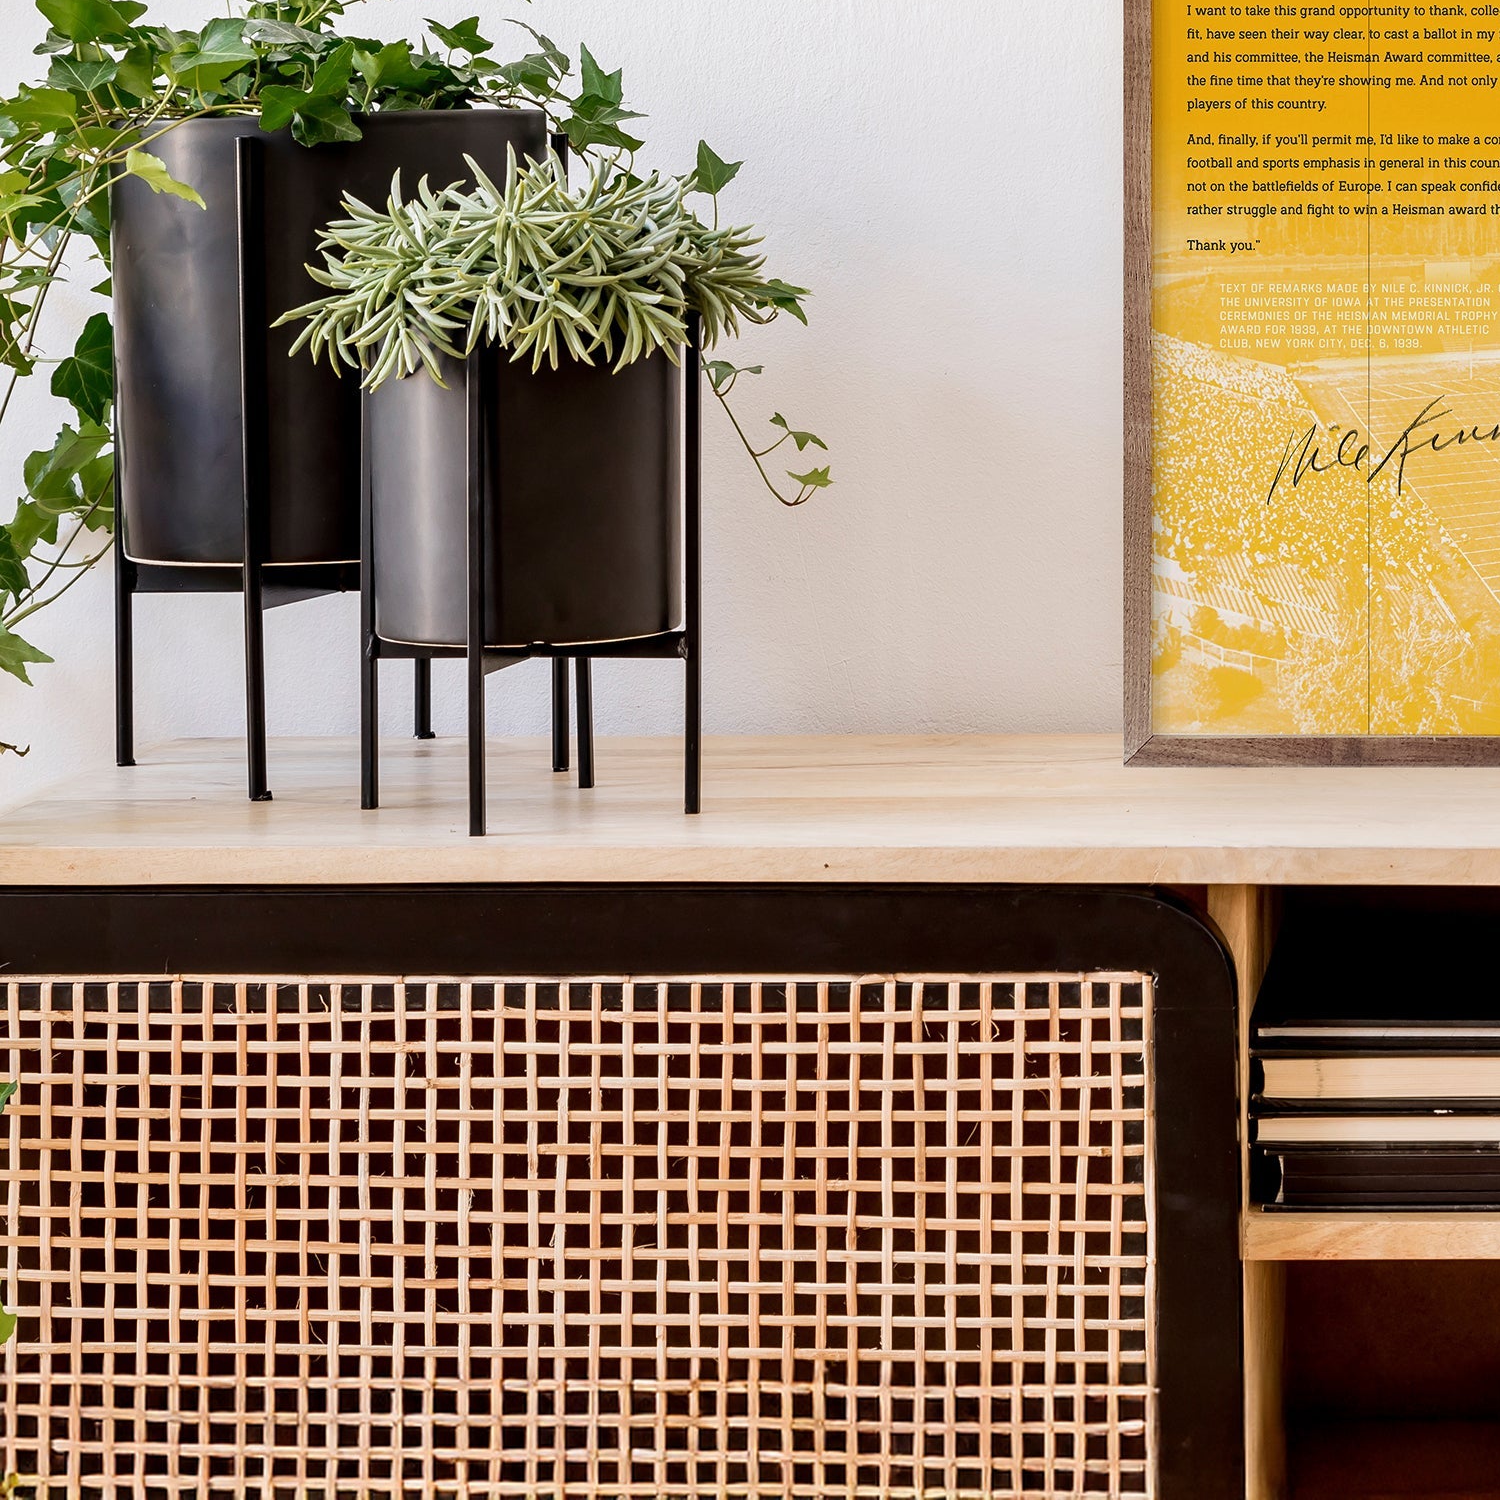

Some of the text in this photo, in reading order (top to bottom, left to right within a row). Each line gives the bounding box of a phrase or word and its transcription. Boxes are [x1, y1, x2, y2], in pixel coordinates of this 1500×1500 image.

[1186, 74, 1207, 87] the
[1209, 74, 1234, 87] fine
[1236, 75, 1264, 87] time
[1266, 74, 1291, 87] that
[1338, 74, 1392, 91] showing
[1395, 77, 1416, 87] me.
[1419, 74, 1445, 86] And
[1447, 75, 1468, 87] not
[1470, 74, 1499, 90] only
[1186, 203, 1224, 216] rather
[1226, 203, 1278, 219] struggle
[1280, 203, 1304, 216] and
[1306, 203, 1335, 219] fight
[1337, 204, 1351, 216] to
[1353, 203, 1378, 216] win
[1381, 206, 1389, 216] a
[1392, 203, 1445, 216] Heisman
[1448, 203, 1487, 216] award
[1186, 239, 1227, 251] Thank
[1219, 283, 1246, 293] TEXT
[1250, 283, 1264, 293] OF
[1268, 283, 1323, 293] REMARKS
[1326, 283, 1358, 293] MADE
[1381, 283, 1405, 293] NILE
[1220, 297, 1240, 307] THE
[1244, 297, 1310, 307] UNIVERSITY
[1314, 297, 1328, 307] OF
[1332, 297, 1361, 307] IOWA
[1383, 297, 1404, 307] THE
[1409, 297, 1491, 307] PRESENTATION
[1219, 310, 1290, 321] CEREMONIES
[1294, 310, 1307, 321] OF
[1312, 310, 1332, 321] THE
[1391, 311, 1450, 321] MEMORIAL
[1455, 311, 1498, 321] TROPHY
[1219, 324, 1261, 335] AWARD
[1265, 324, 1286, 335] FOR
[1323, 324, 1337, 334] AT
[1342, 324, 1361, 335] THE
[1437, 324, 1489, 335] ATHLETIC
[1255, 338, 1281, 349] NEW
[1285, 338, 1314, 349] YORK
